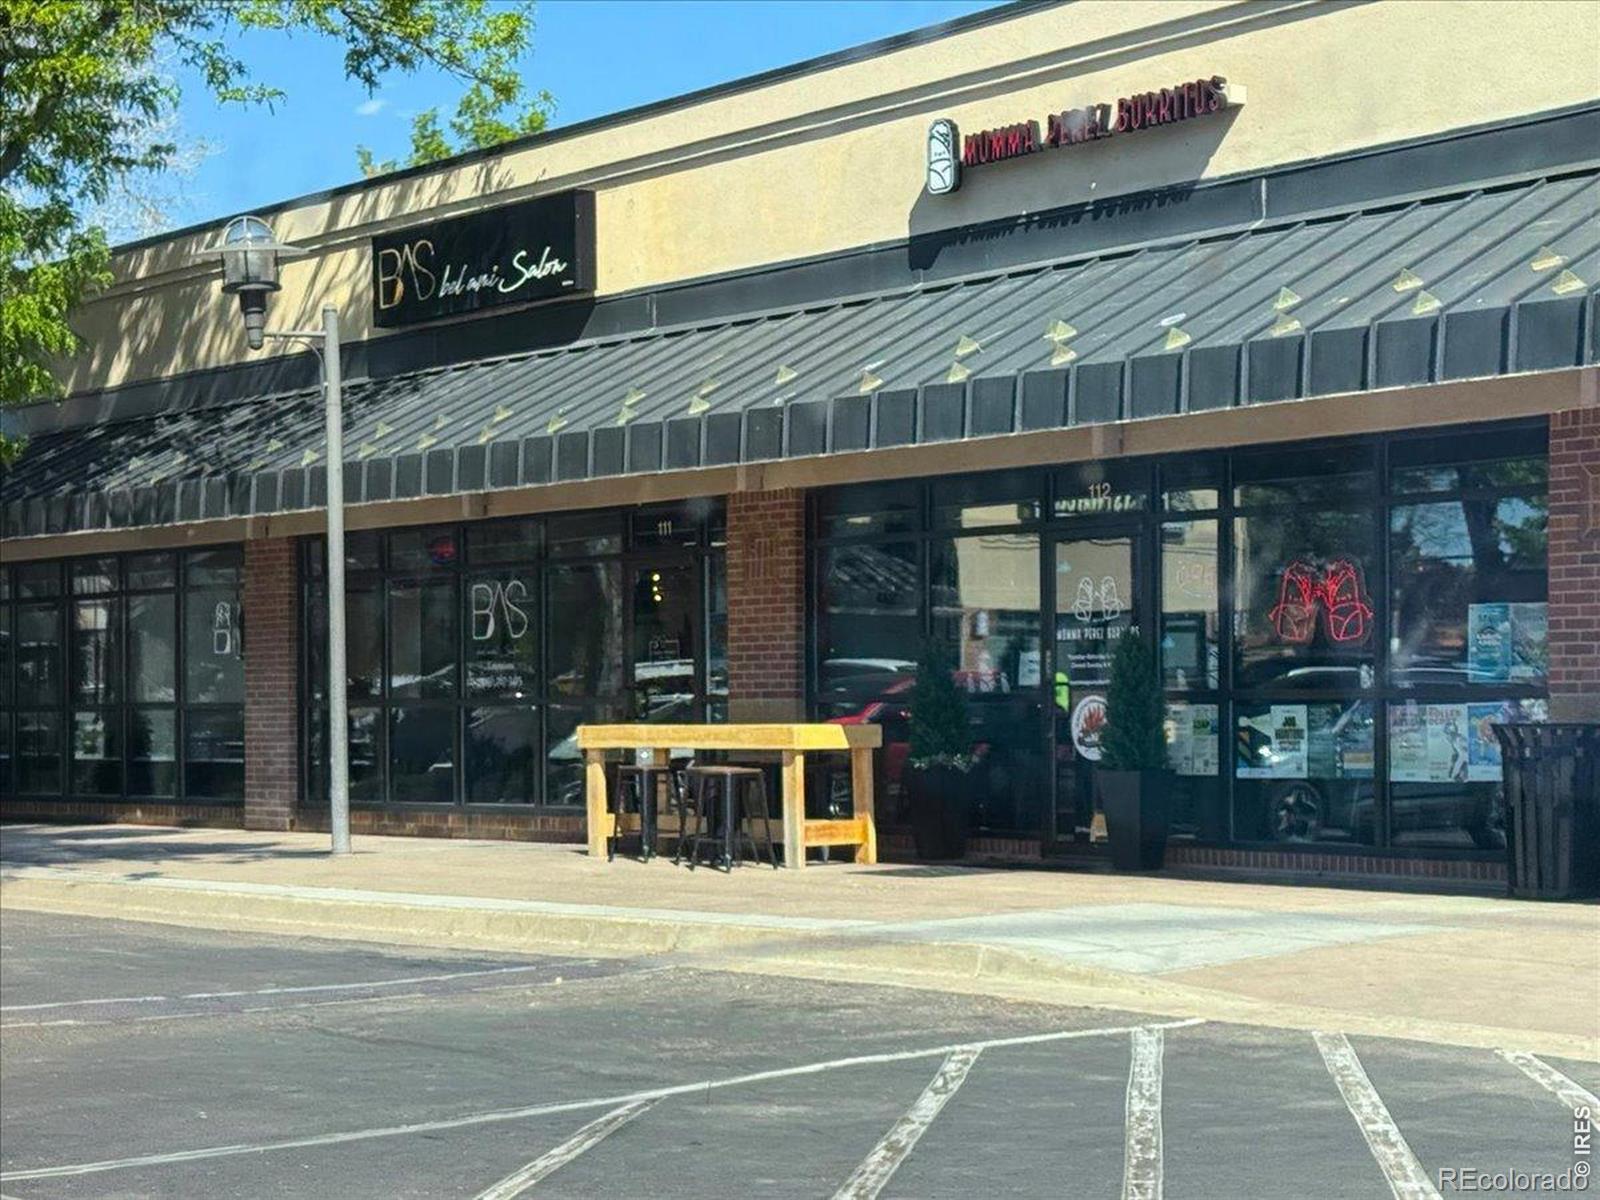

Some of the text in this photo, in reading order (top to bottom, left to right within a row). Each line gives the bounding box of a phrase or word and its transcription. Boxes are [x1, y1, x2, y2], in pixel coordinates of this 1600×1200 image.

[1116, 75, 1227, 132] BURRITOS
[498, 246, 568, 293] Salon
[1089, 482, 1111, 500] 112
